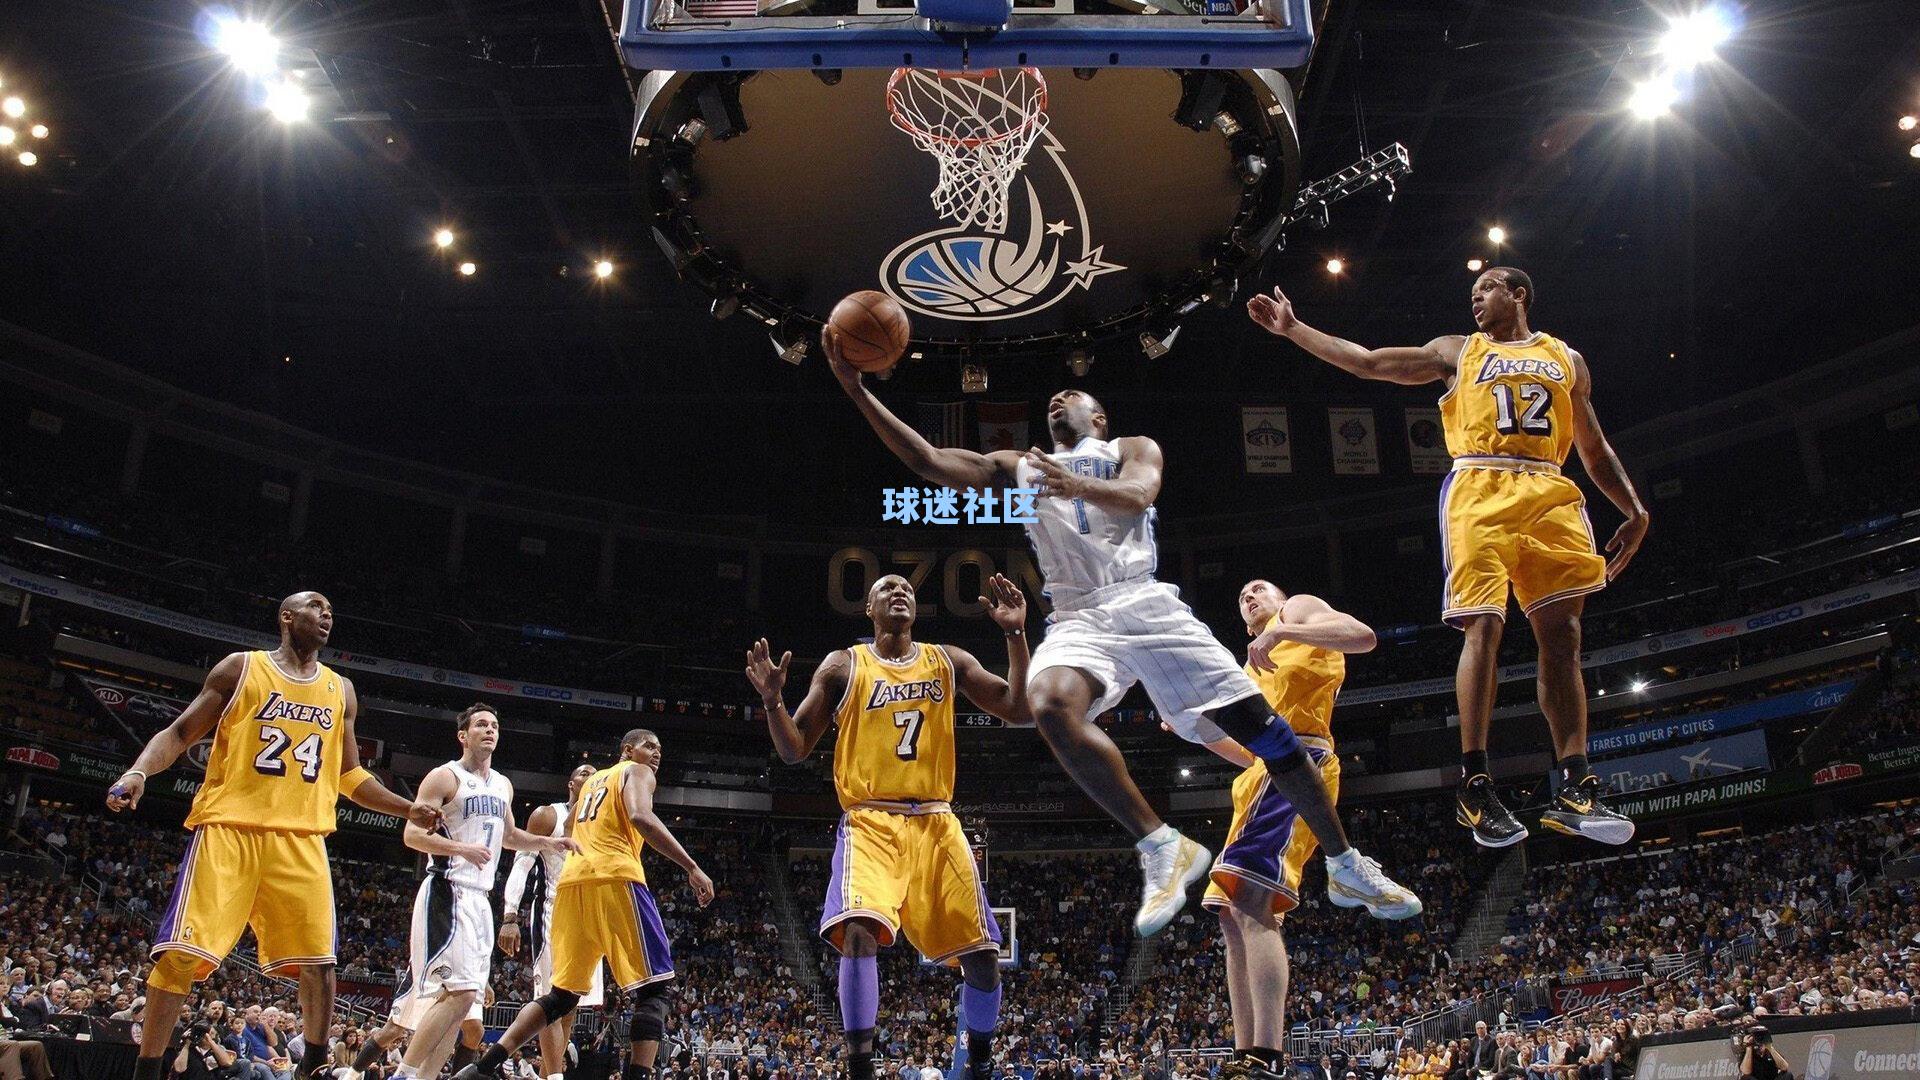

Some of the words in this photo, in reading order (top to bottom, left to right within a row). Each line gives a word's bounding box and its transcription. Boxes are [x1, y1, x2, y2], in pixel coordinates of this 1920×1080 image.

[1477, 353, 1566, 384] LAKERS
[1491, 382, 1553, 436] 12
[1072, 498, 1090, 534] 1
[9, 576, 58, 596] PEPSICO
[1746, 606, 1803, 629] GEICO
[97, 689, 121, 702] KIA
[522, 685, 572, 700] GEICO
[868, 680, 945, 711] LAKERS
[254, 691, 334, 731] LAKERS
[966, 715, 991, 726] 4:52
[893, 710, 923, 760] 7
[1593, 737, 1622, 752] FARES
[1625, 734, 1636, 746] TO
[1639, 728, 1664, 744] OVER
[1682, 718, 1715, 735] CITIES
[70, 752, 96, 766] Better
[254, 726, 323, 784] 24
[1868, 748, 1896, 762] Better
[1884, 756, 1911, 768] Better
[81, 765, 106, 778] Better
[577, 787, 608, 823] 17
[983, 802, 1037, 811] BASELINE
[1040, 802, 1064, 811] BAR
[1619, 801, 1644, 816] WIN
[1649, 795, 1680, 813] WITH
[1685, 788, 1716, 805] PAPA
[1720, 778, 1767, 798] JOHNS!
[355, 811, 400, 829] JOHNS!
[483, 822, 494, 848] 7
[1657, 1060, 1698, 1080] Connect
[1700, 1060, 1712, 1077] at
